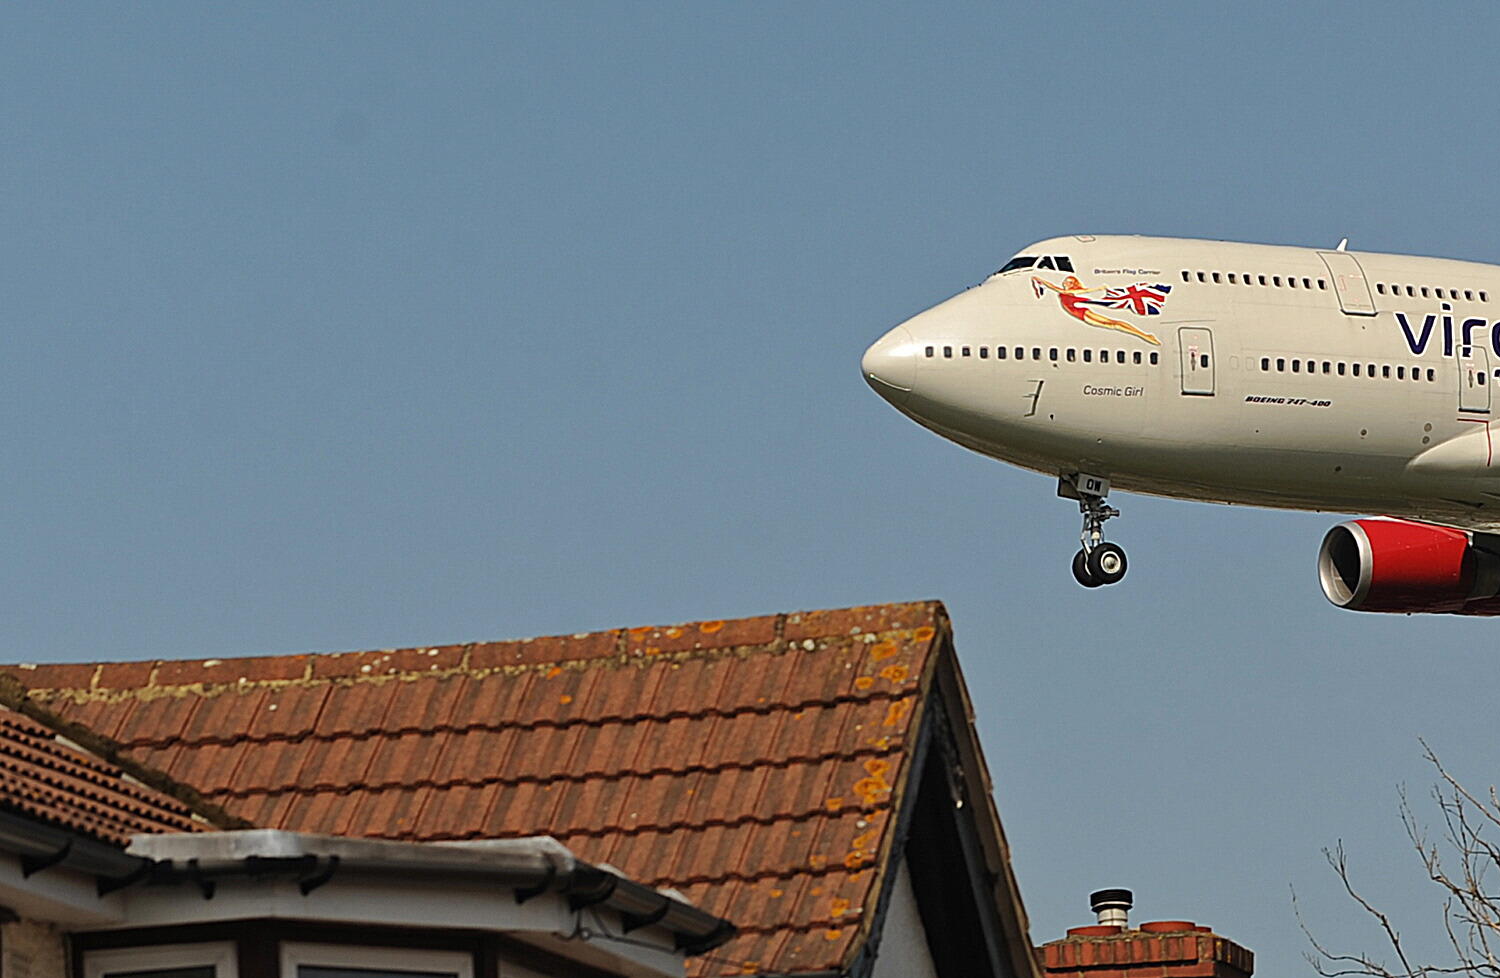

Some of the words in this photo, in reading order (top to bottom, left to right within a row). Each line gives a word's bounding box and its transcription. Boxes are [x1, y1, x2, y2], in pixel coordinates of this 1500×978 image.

[1083, 384, 1122, 397] Cosmic
[1124, 386, 1144, 397] Girl
[1245, 395, 1286, 405] BOEING
[1287, 397, 1332, 408] 747-400
